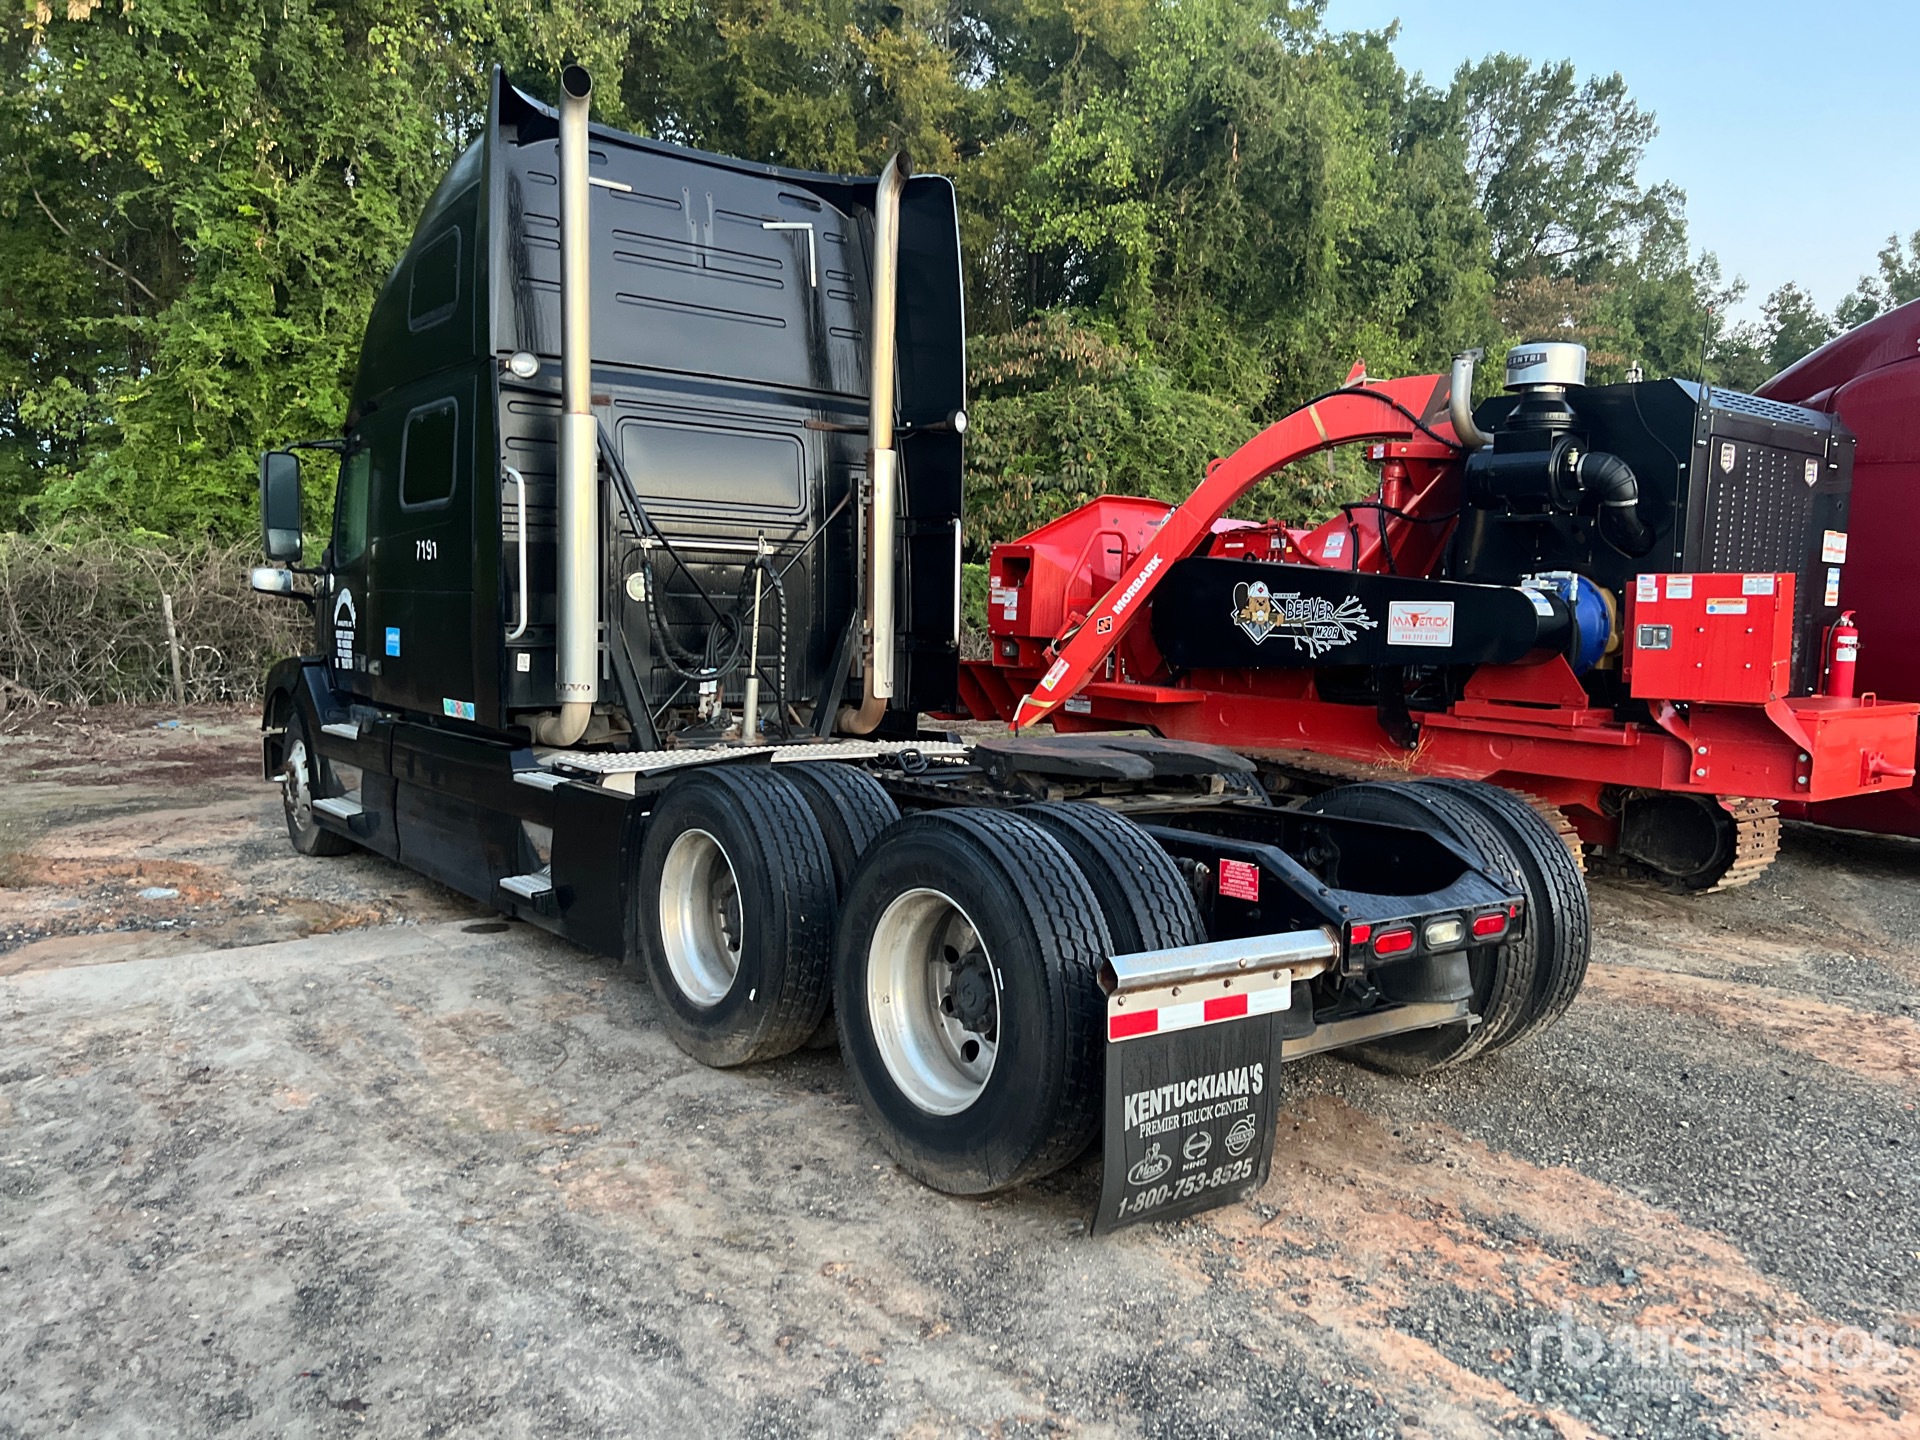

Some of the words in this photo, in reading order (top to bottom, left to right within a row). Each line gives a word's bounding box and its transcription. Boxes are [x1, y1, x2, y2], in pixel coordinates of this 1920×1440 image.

[415, 539, 437, 562] 7191
[1112, 552, 1164, 616] MORBARK
[1285, 597, 1334, 621] BEEVER
[1393, 614, 1449, 627] MAVERICK
[1124, 1063, 1263, 1131] KENTUCKIANA'S
[1139, 1114, 1179, 1139] PREMIER
[1181, 1105, 1213, 1126] TRUCK
[1215, 1097, 1248, 1118] CENTER
[1117, 1157, 1253, 1219] 1-800-753-8525
